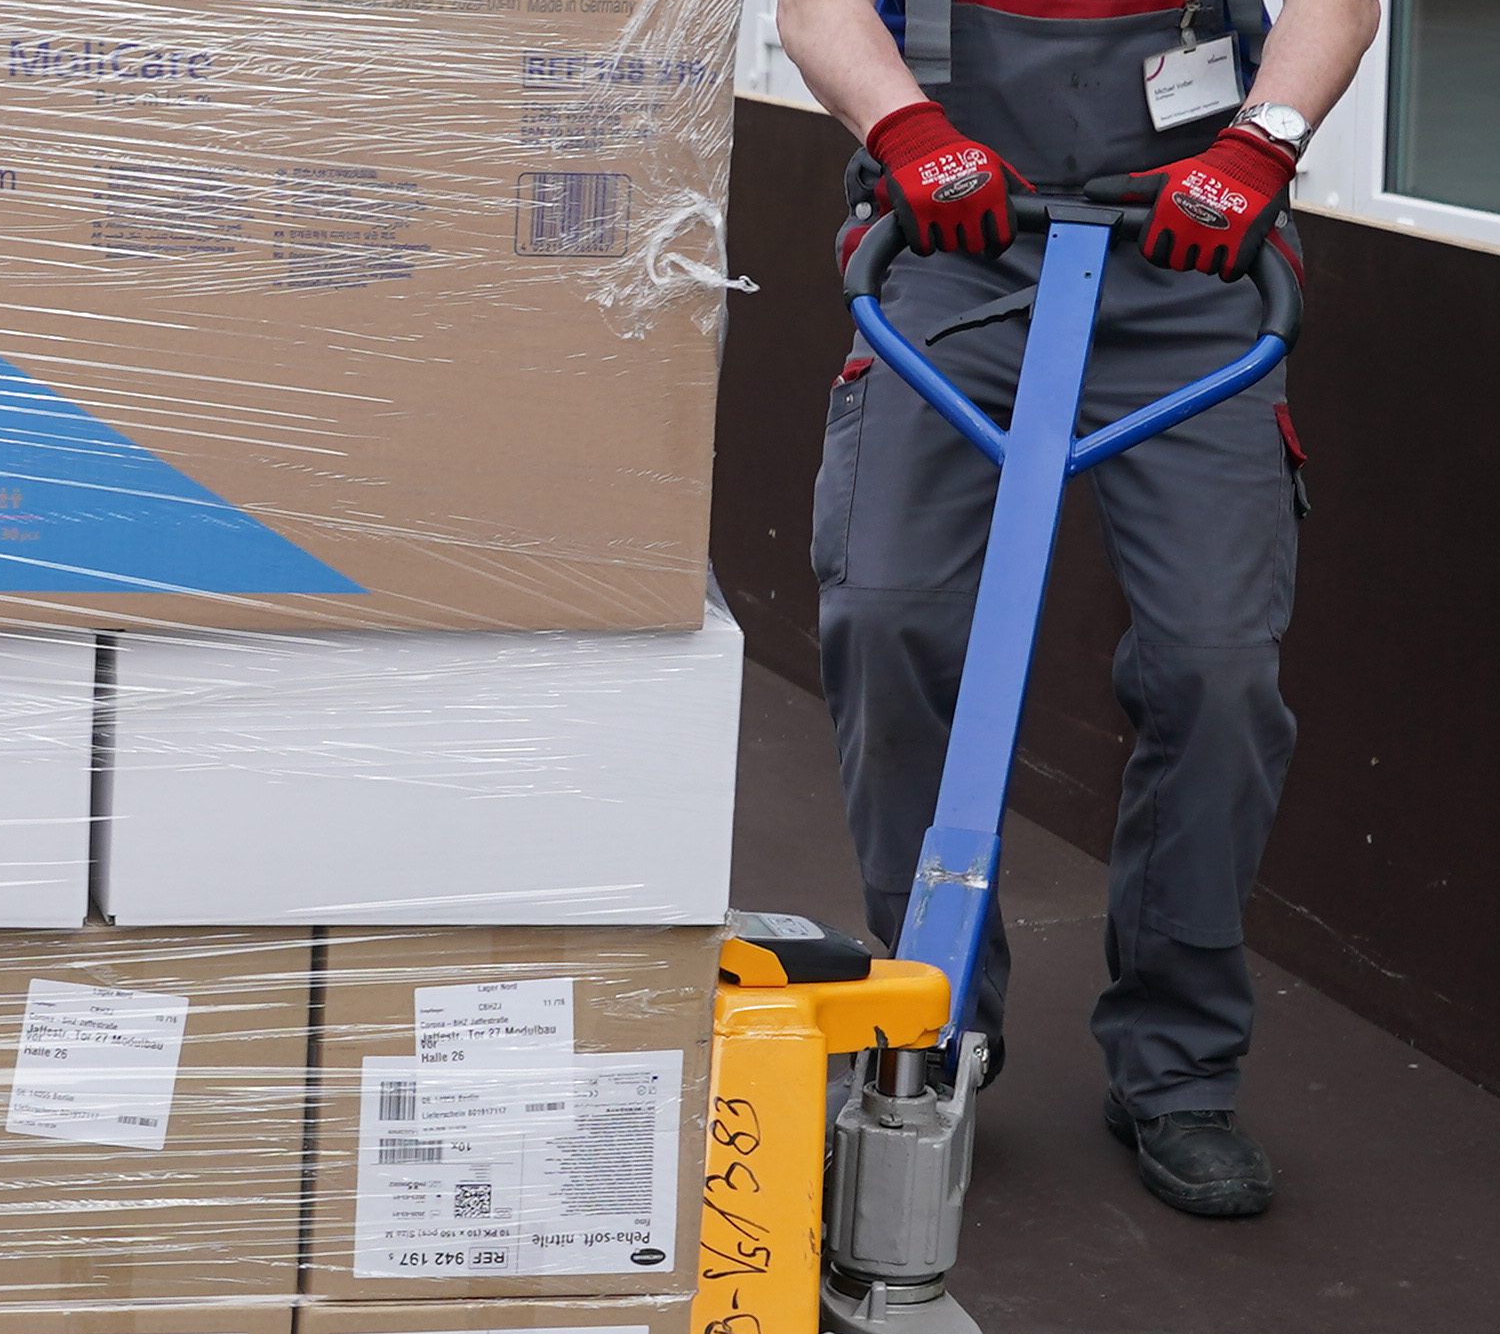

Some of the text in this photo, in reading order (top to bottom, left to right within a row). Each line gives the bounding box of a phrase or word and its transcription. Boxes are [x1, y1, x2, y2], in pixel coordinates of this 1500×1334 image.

[0, 527, 19, 541] 30
[477, 983, 518, 993] Lager Nord
[468, 1029, 485, 1040] Tor
[488, 1027, 501, 1038] 27
[505, 1024, 557, 1037] Modulbau
[23, 1045, 52, 1058] Halle
[421, 1050, 465, 1064] Halle 26
[531, 1233, 574, 1248] nitrile
[399, 1251, 429, 1266] 197
[434, 1251, 465, 1266] 942
[472, 1251, 506, 1265] REF
